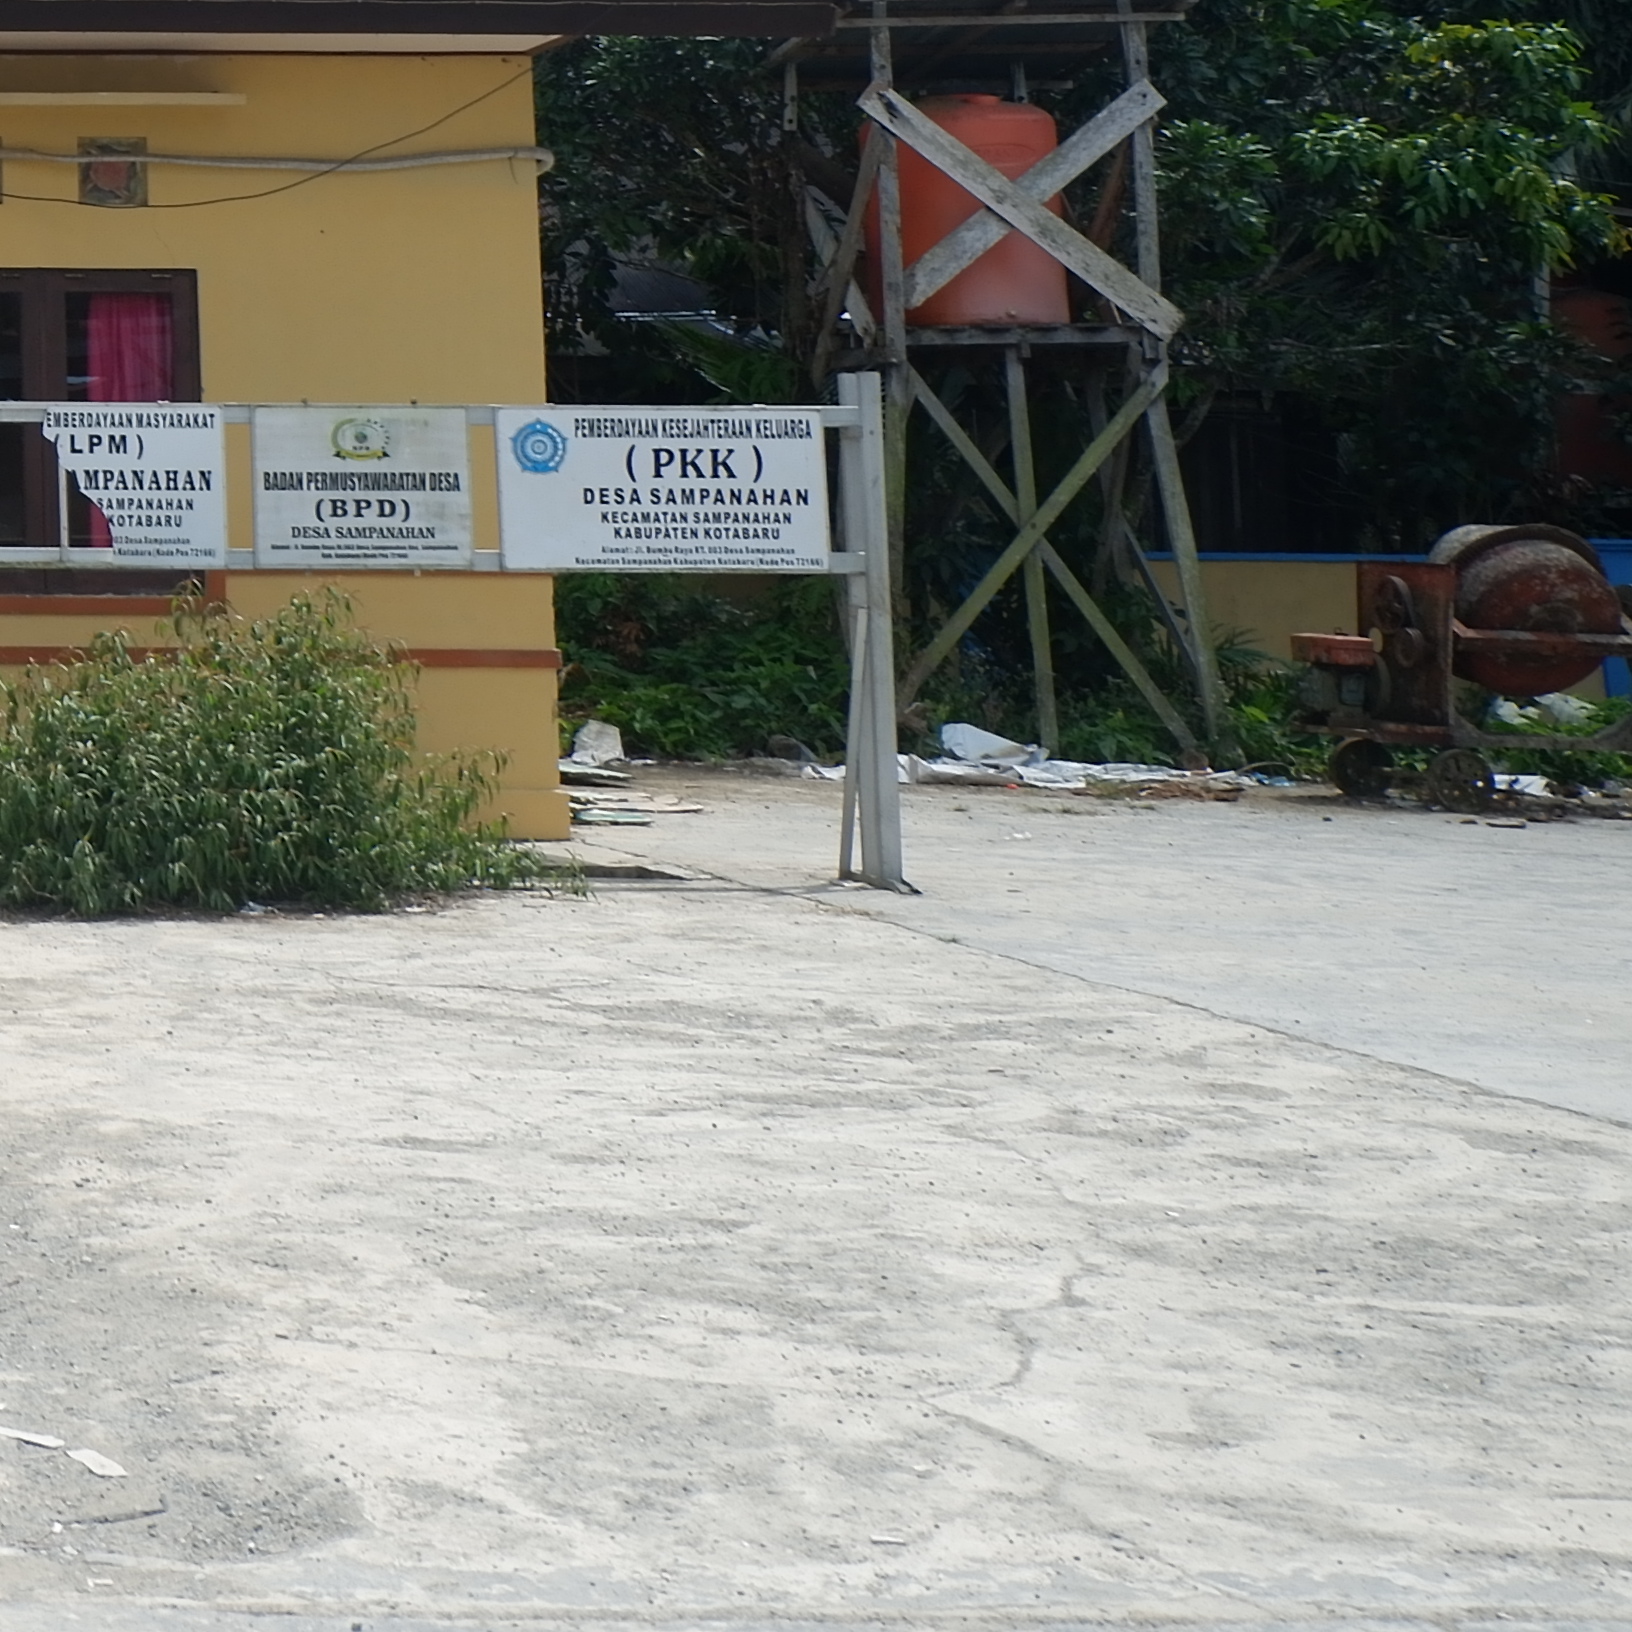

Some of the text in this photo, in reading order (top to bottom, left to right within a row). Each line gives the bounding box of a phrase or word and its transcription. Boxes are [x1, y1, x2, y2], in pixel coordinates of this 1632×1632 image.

[135, 412, 215, 429] MASYARAKAT
[574, 418, 813, 439] PEMBERDAYAAN KESEJAHTERAAN KELUARGA
[263, 471, 461, 492] BADAN PERMUSYAWARATAN DESA
[583, 487, 809, 506] DESA SAMPANAHAN
[314, 498, 411, 522] (BPD)
[601, 511, 792, 525] KECAMATAN SAMPANAHAN
[291, 526, 436, 539] DESA SAMPANAHAN
[614, 527, 780, 540] KABUPATEN KOTABARU
